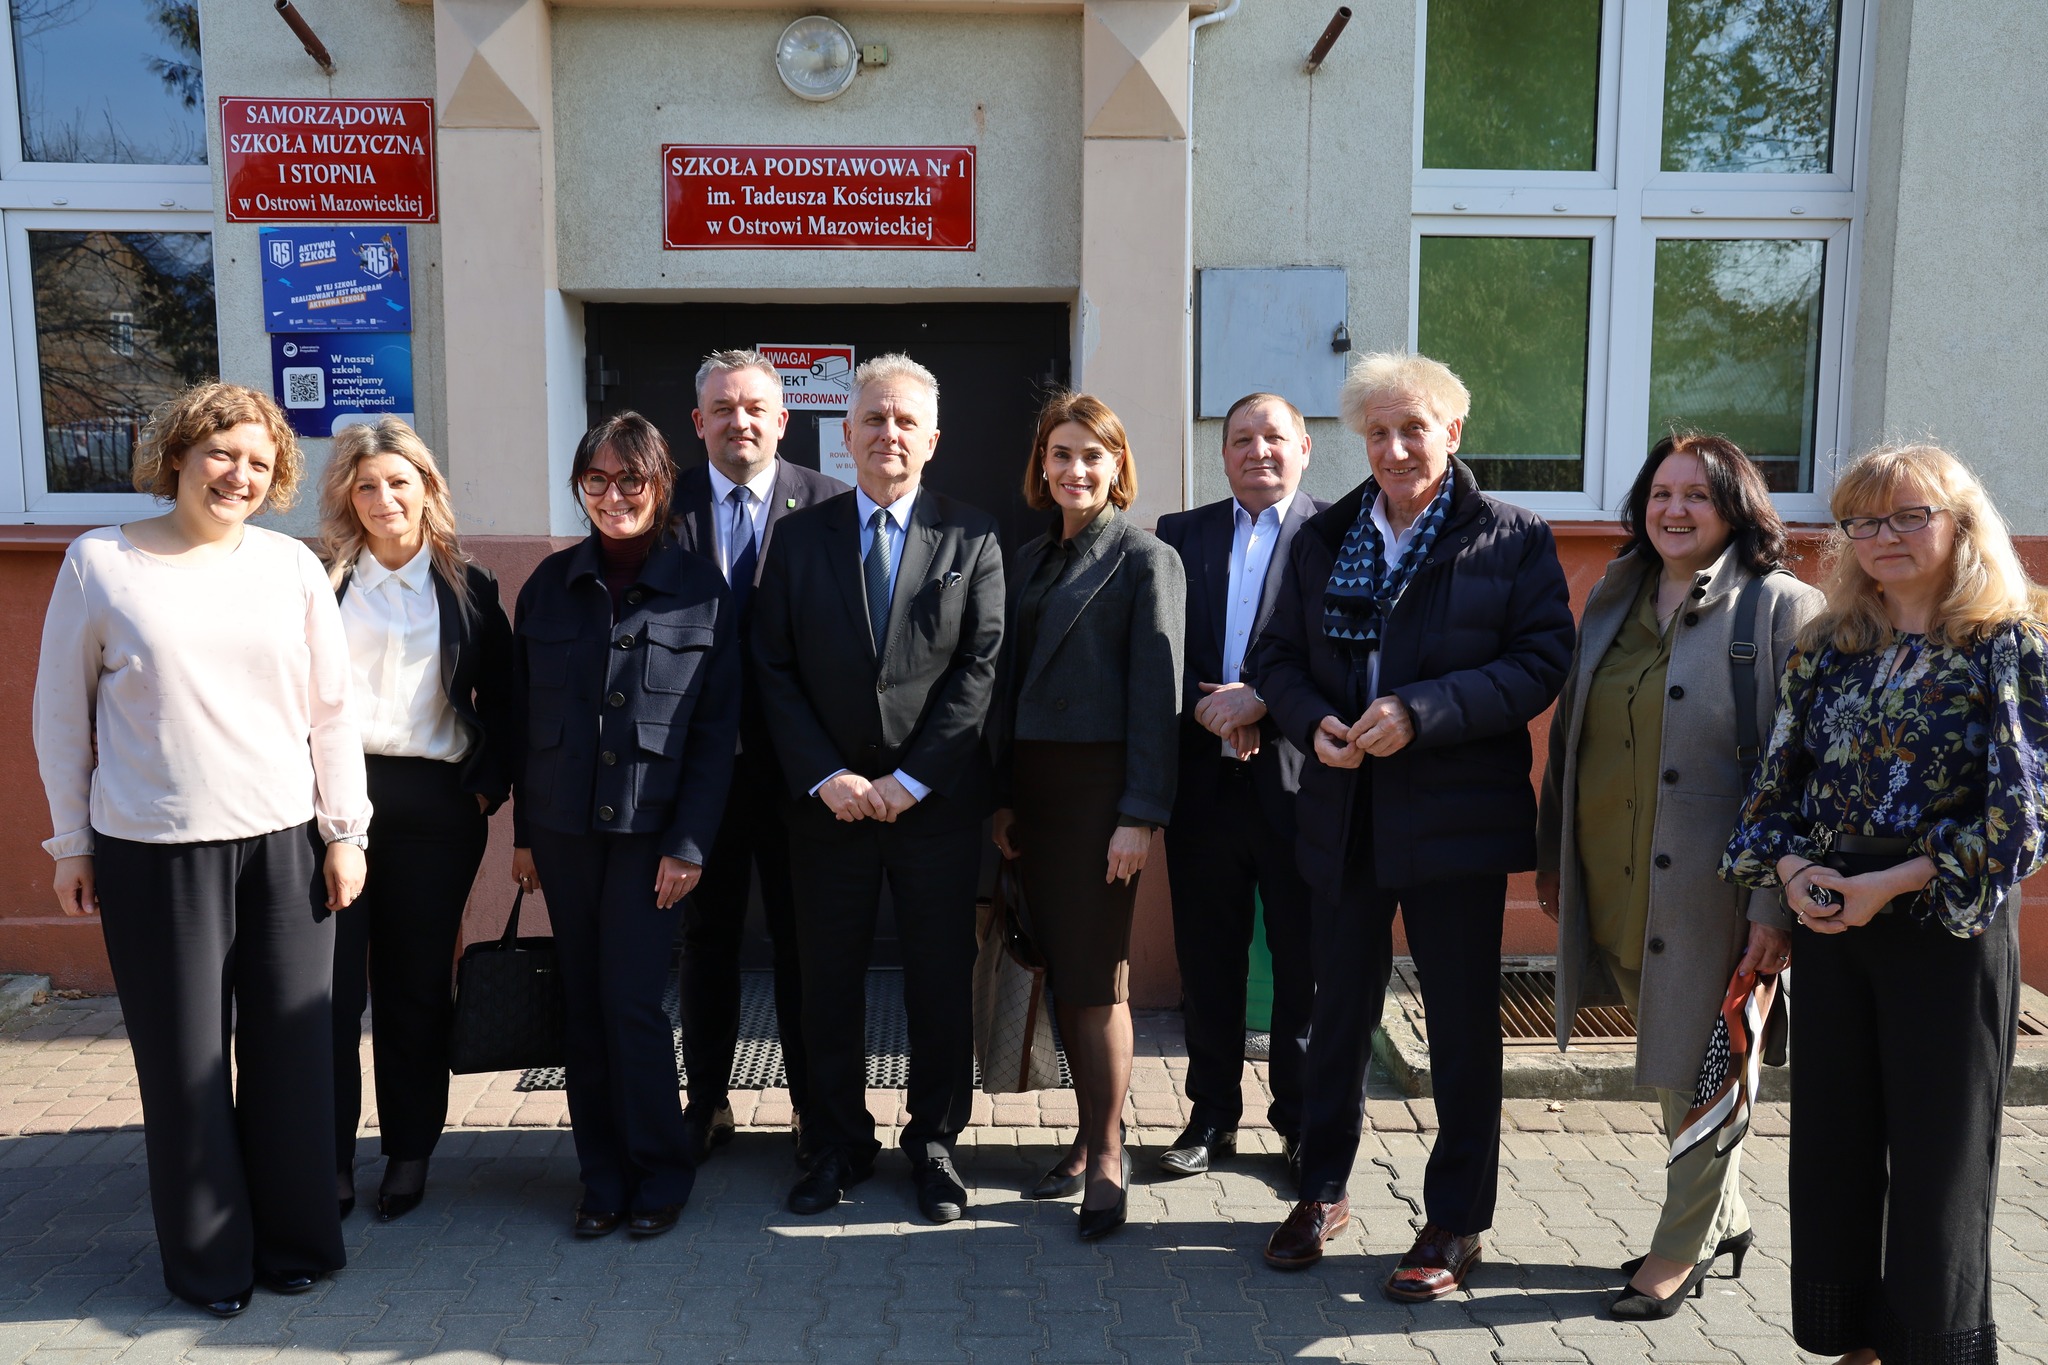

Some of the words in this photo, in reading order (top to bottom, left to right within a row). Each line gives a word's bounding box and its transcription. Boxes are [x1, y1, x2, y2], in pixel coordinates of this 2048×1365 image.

[246, 105, 406, 129] SAMORZĄDOWA
[230, 134, 307, 154] SZKOŁA
[312, 134, 425, 155] MUZYCZNA
[278, 163, 285, 184] I
[291, 163, 376, 184] STOPNIA
[671, 156, 758, 177] SZKOŁA
[764, 157, 920, 177] PODSTAWOWA
[926, 158, 950, 177] Nr
[958, 159, 965, 178] 1
[238, 198, 251, 211] w
[255, 193, 317, 212] Ostrowi
[319, 193, 423, 217] Mazowieckiej
[706, 186, 736, 205] im.
[741, 185, 827, 206] Tadeusza
[833, 185, 931, 206] Kościuszki
[706, 220, 722, 235] w
[728, 215, 802, 235] Ostrowi
[807, 215, 933, 240] Mazowieckiej
[272, 242, 291, 265] AS
[299, 240, 336, 253] AKTYWNA
[299, 247, 336, 263] SZKOŁA
[367, 246, 389, 275] AS
[290, 290, 334, 304] REALIZOWANY
[335, 288, 349, 297] JEST
[350, 283, 382, 294] PROGRAM
[323, 283, 333, 291] TEJ
[334, 280, 357, 289] SZKOLE
[309, 297, 340, 309] AKTYWNA
[330, 354, 342, 364] W
[344, 354, 374, 365] naszej
[331, 365, 362, 374] szkole
[332, 376, 383, 387] rozwijamy
[333, 387, 386, 399] praktyczne
[333, 396, 395, 408] umiejętności!
